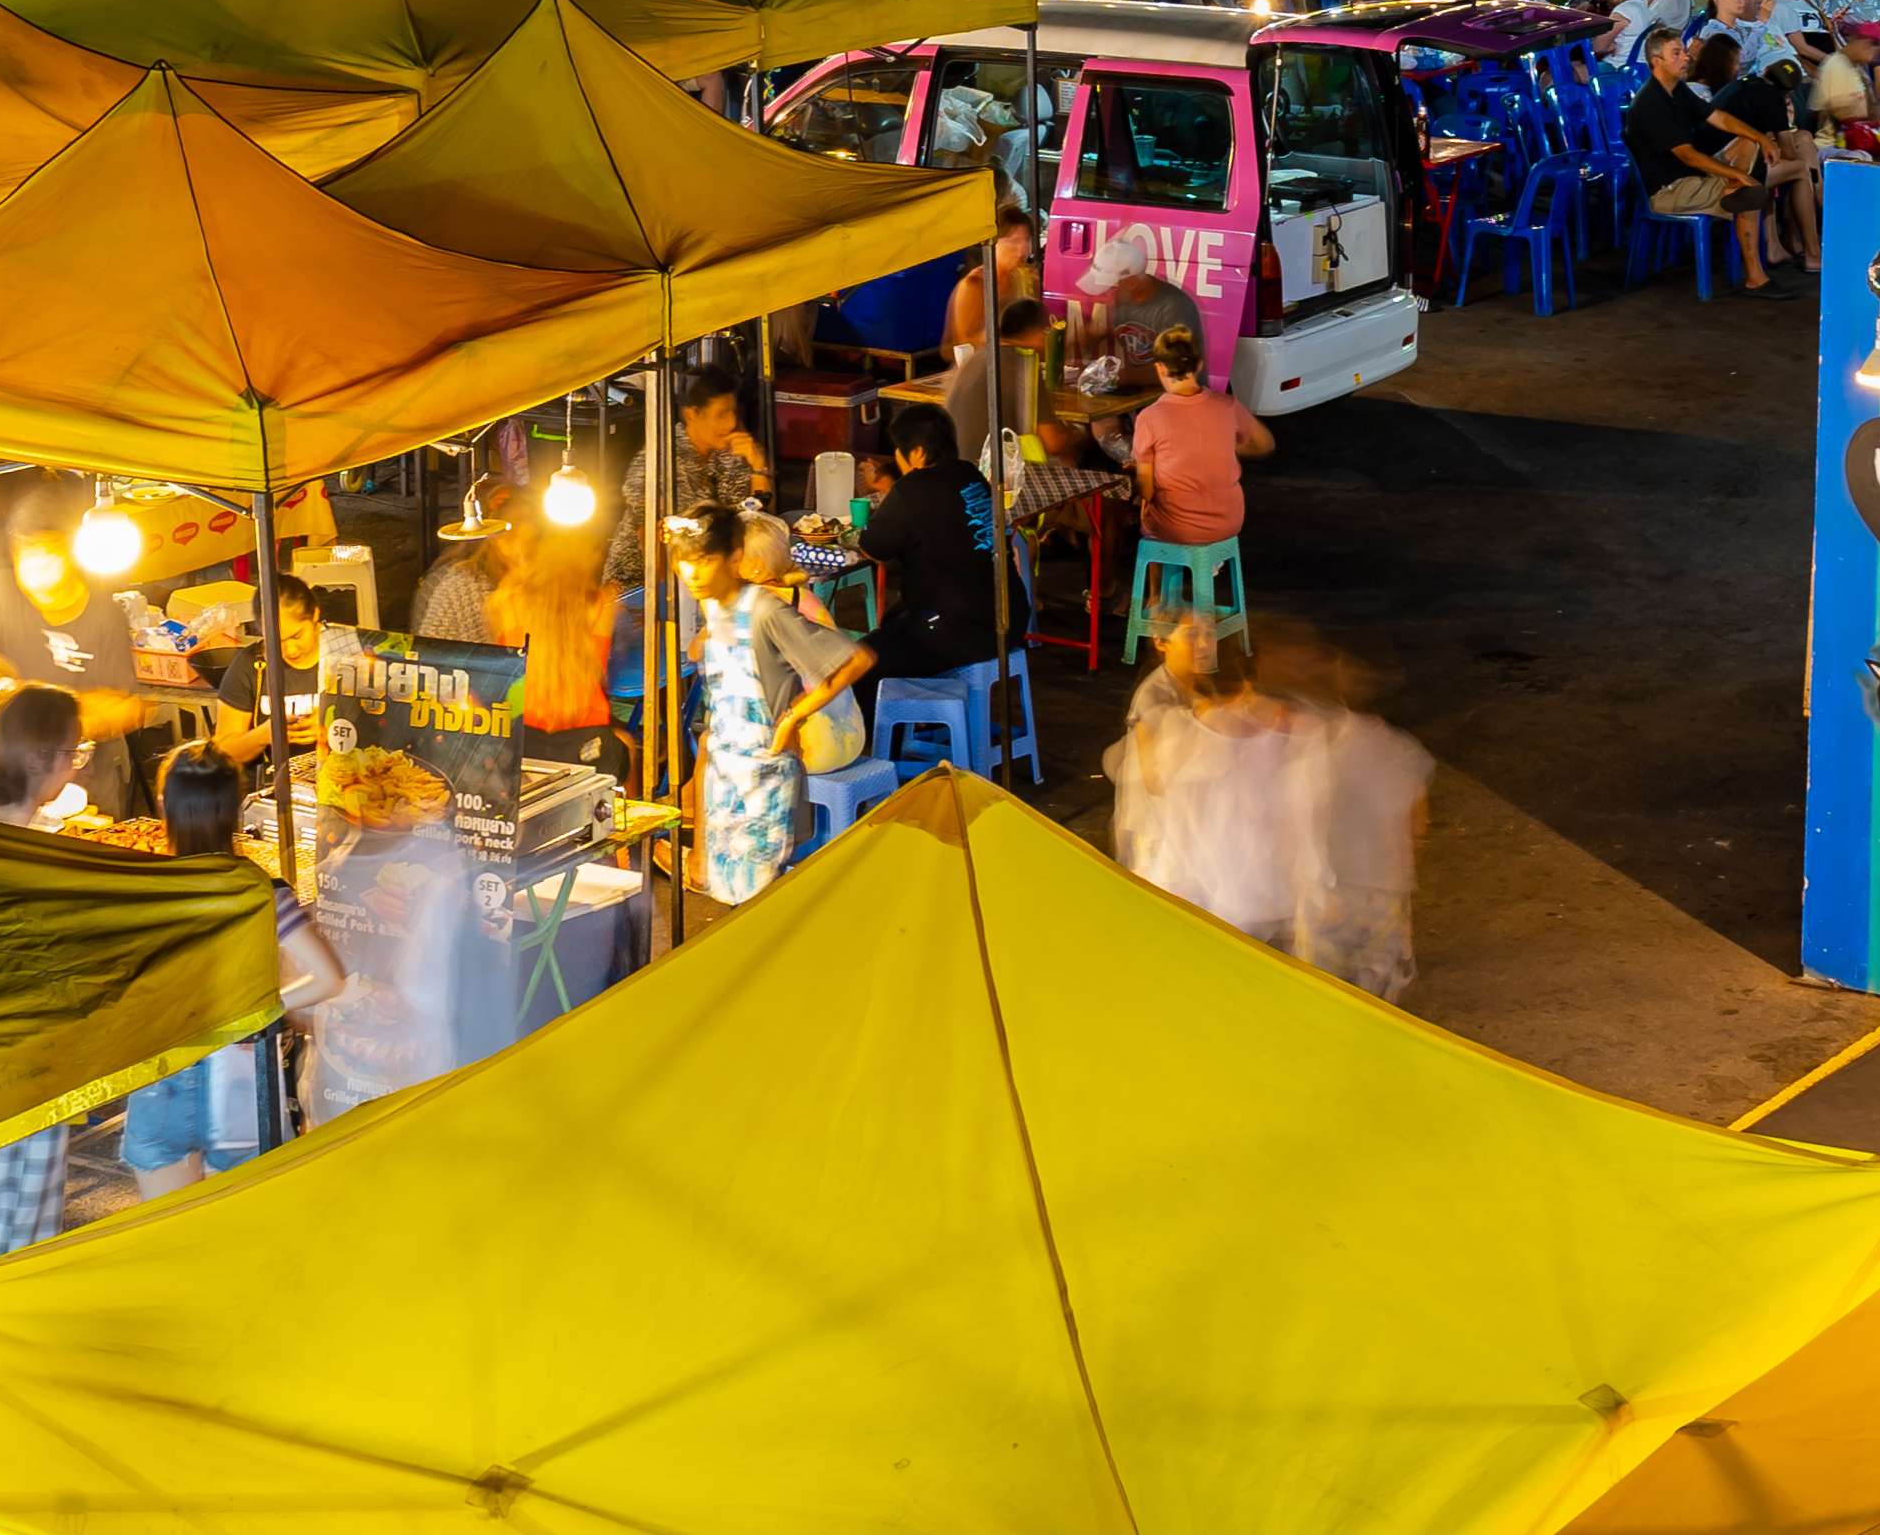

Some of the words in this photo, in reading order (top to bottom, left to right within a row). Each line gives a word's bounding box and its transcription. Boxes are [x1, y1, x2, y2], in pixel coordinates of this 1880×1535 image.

[332, 725, 352, 738] SET
[339, 740, 345, 752] 1
[411, 824, 452, 842] Grilled
[454, 829, 483, 847] pork
[485, 836, 515, 851] neck
[478, 879, 500, 893] SET
[485, 895, 492, 907] 2
